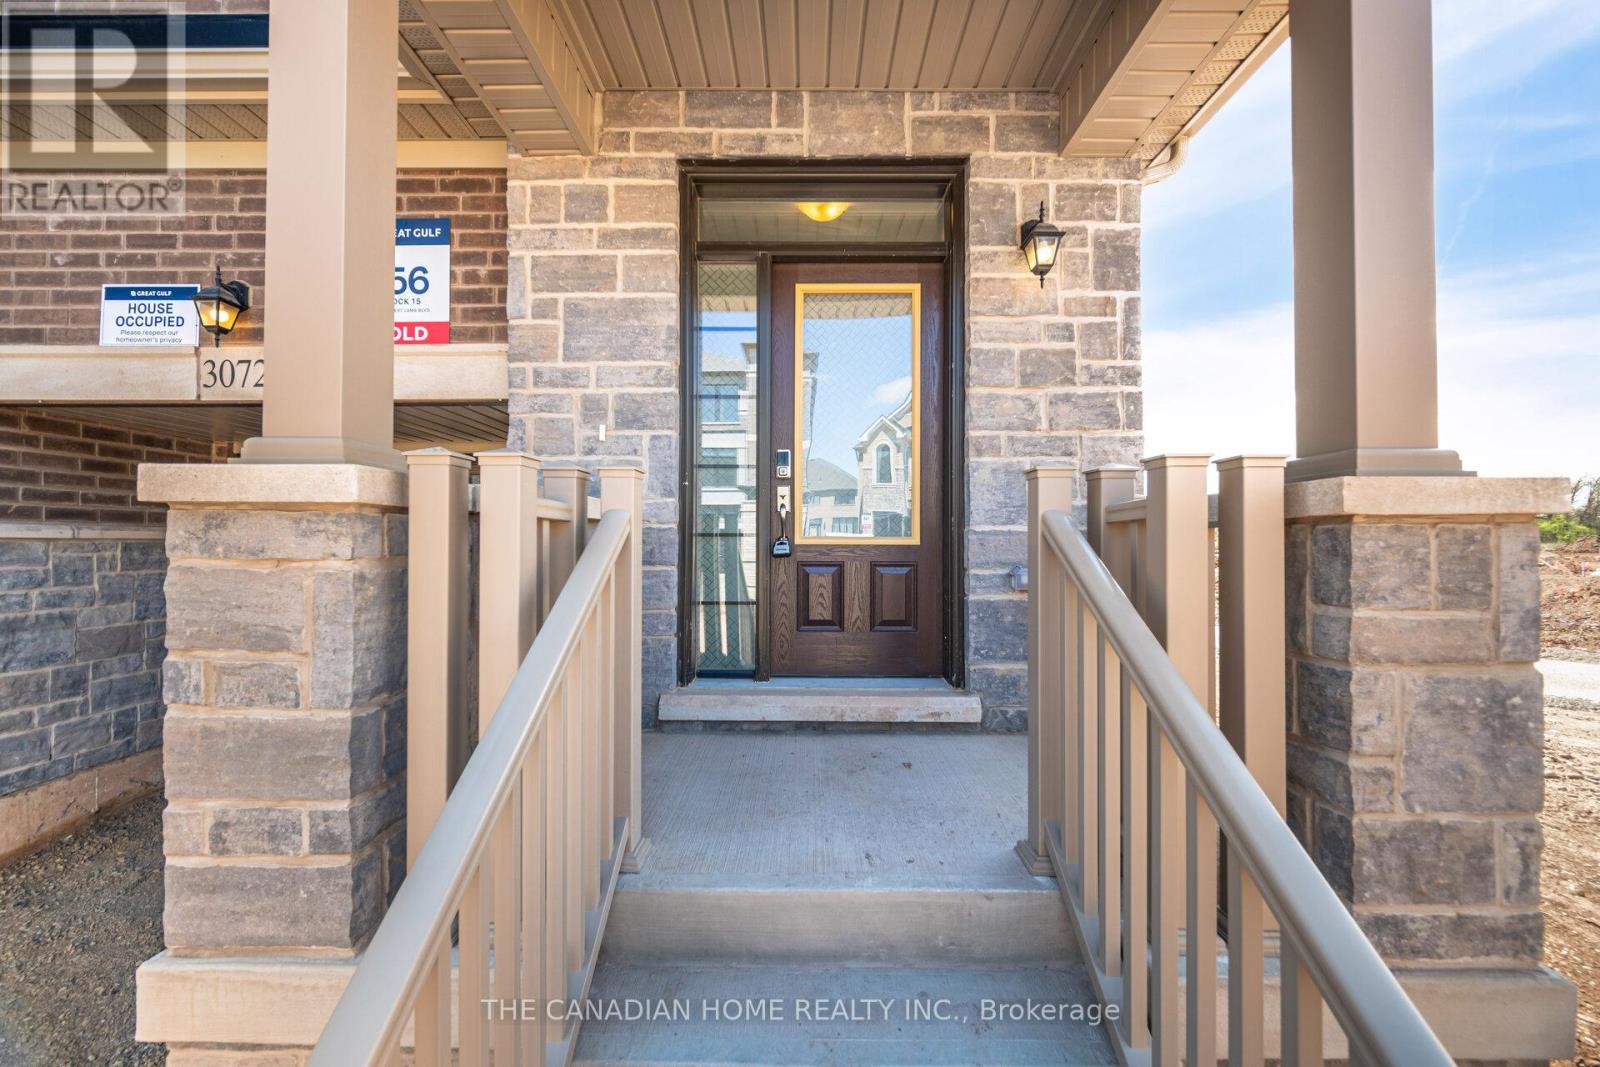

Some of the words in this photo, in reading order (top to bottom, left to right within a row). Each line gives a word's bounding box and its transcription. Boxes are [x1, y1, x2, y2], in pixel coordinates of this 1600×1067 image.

[413, 228, 442, 237] GULF
[128, 303, 173, 314] HOUSE
[115, 316, 185, 327] OCCUPIED
[160, 336, 183, 344] privacy
[202, 359, 264, 388] 3072
